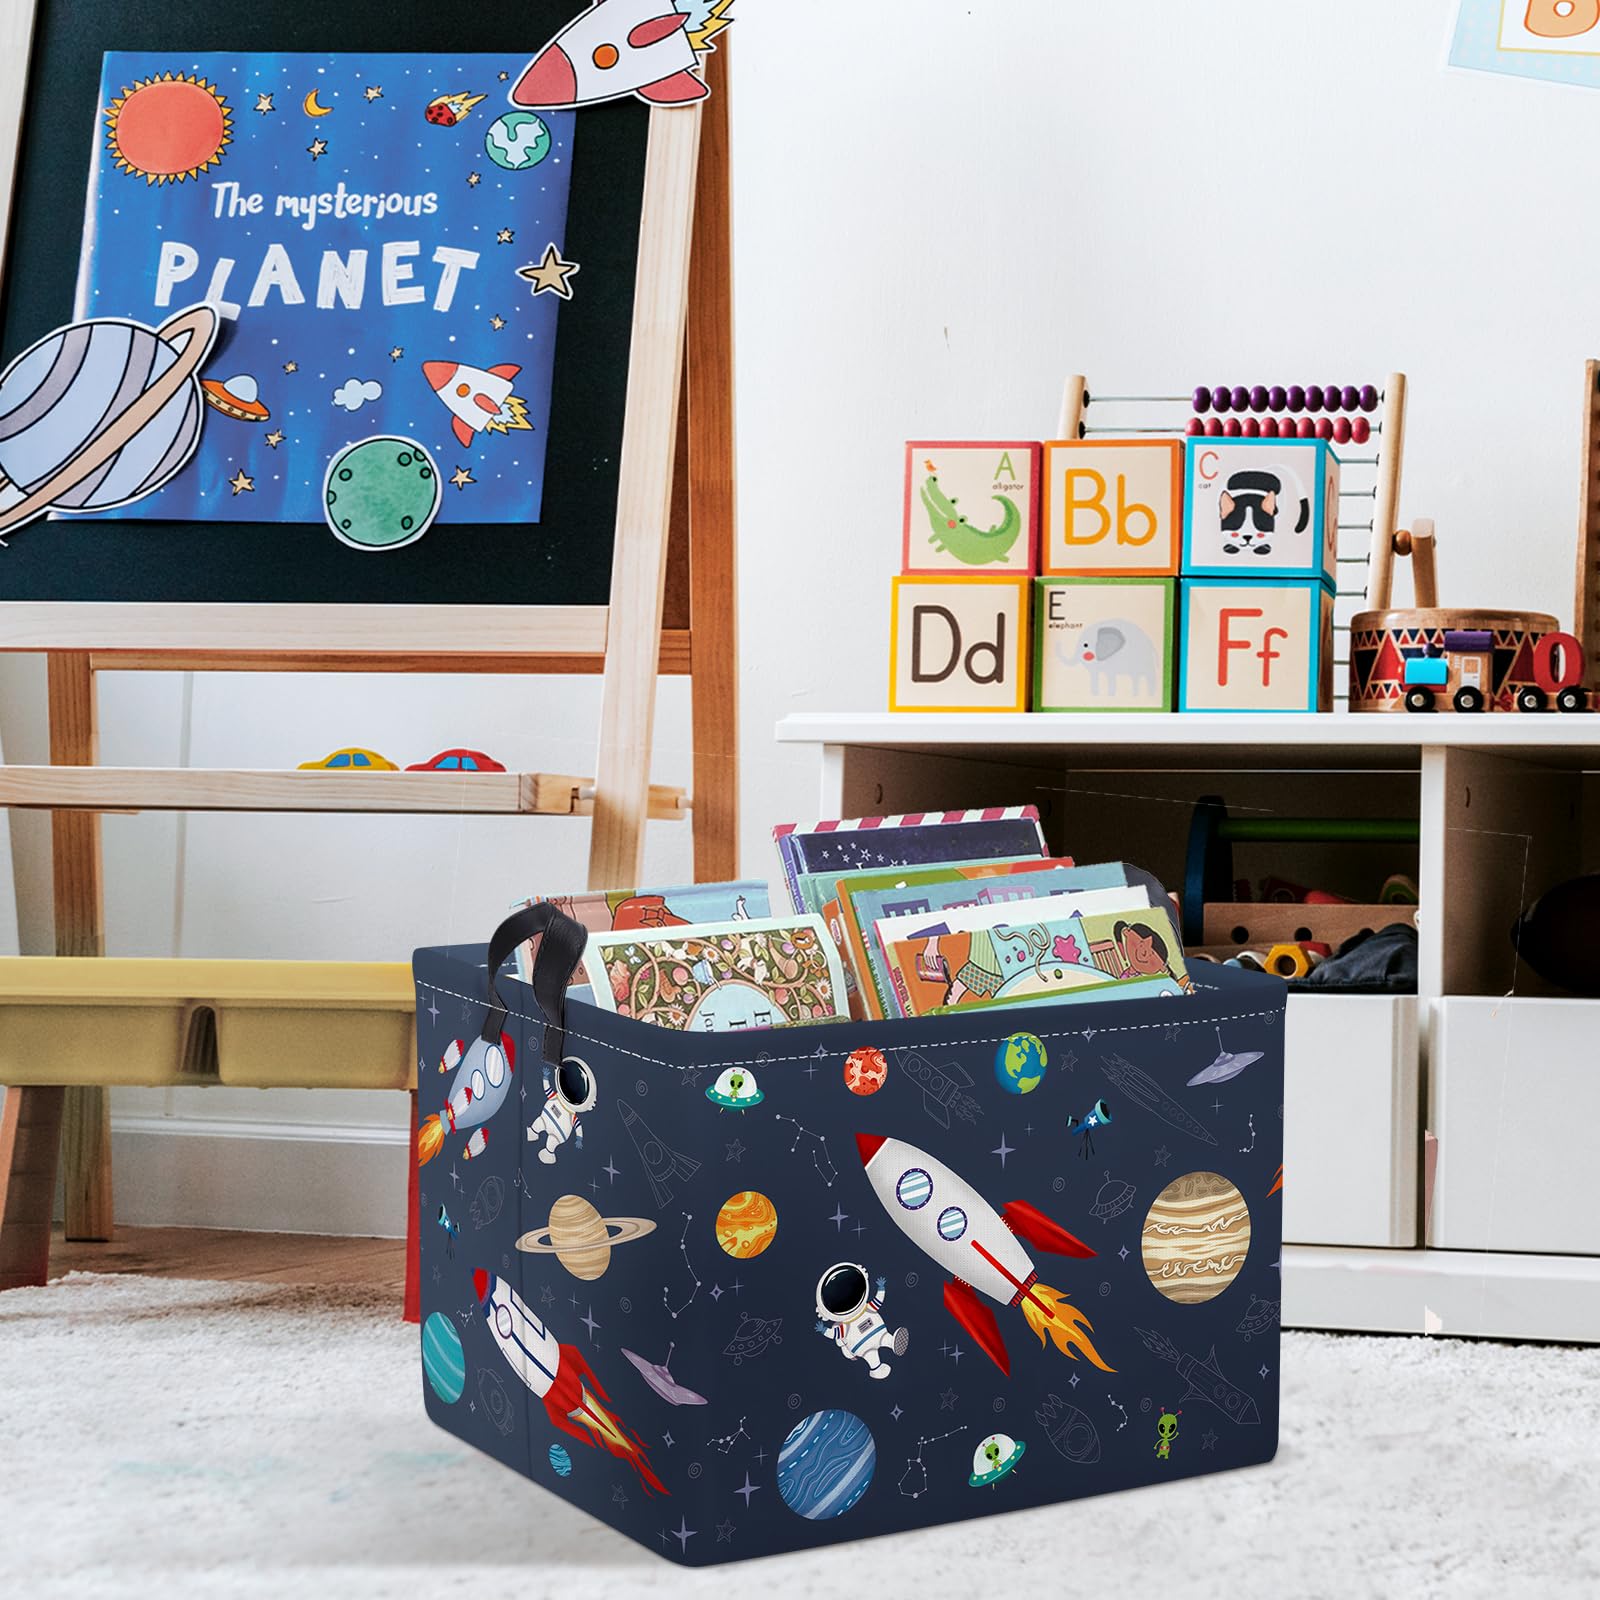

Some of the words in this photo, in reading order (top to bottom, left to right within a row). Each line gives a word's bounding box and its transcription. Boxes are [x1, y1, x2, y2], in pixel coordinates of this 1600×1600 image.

[211, 181, 264, 218] The
[274, 182, 438, 231] mysterious
[153, 240, 481, 321] PLANET
[993, 451, 1016, 481] A
[1199, 451, 1219, 480] C
[992, 482, 1025, 492] alligator
[1064, 468, 1158, 547] Bb
[1048, 591, 1066, 620] E
[911, 605, 1006, 685] Dd
[1048, 622, 1083, 630] elephant
[1217, 608, 1289, 687] Ff
